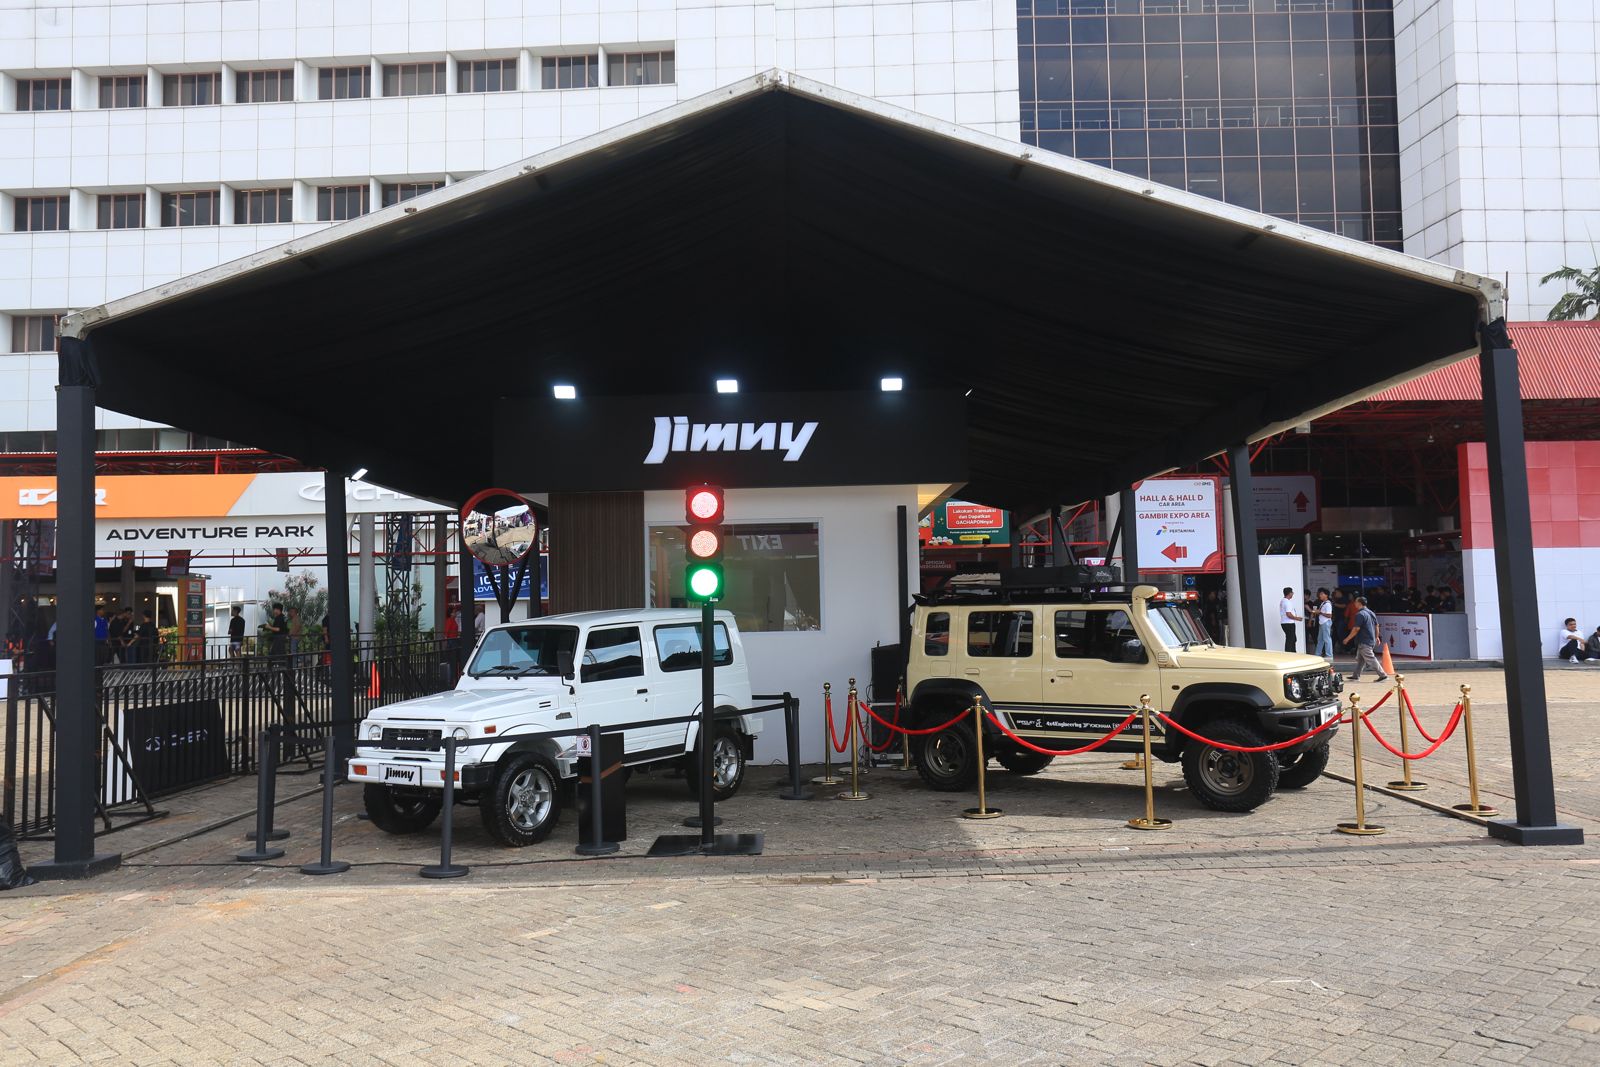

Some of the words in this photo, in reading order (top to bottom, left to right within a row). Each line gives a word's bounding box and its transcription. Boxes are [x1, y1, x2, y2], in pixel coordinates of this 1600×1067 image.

[643, 416, 819, 464] Jimny
[1168, 494, 1175, 502] &
[106, 526, 248, 541] ADVENTURE
[254, 525, 314, 539] PARK
[384, 767, 415, 782] Jimny
